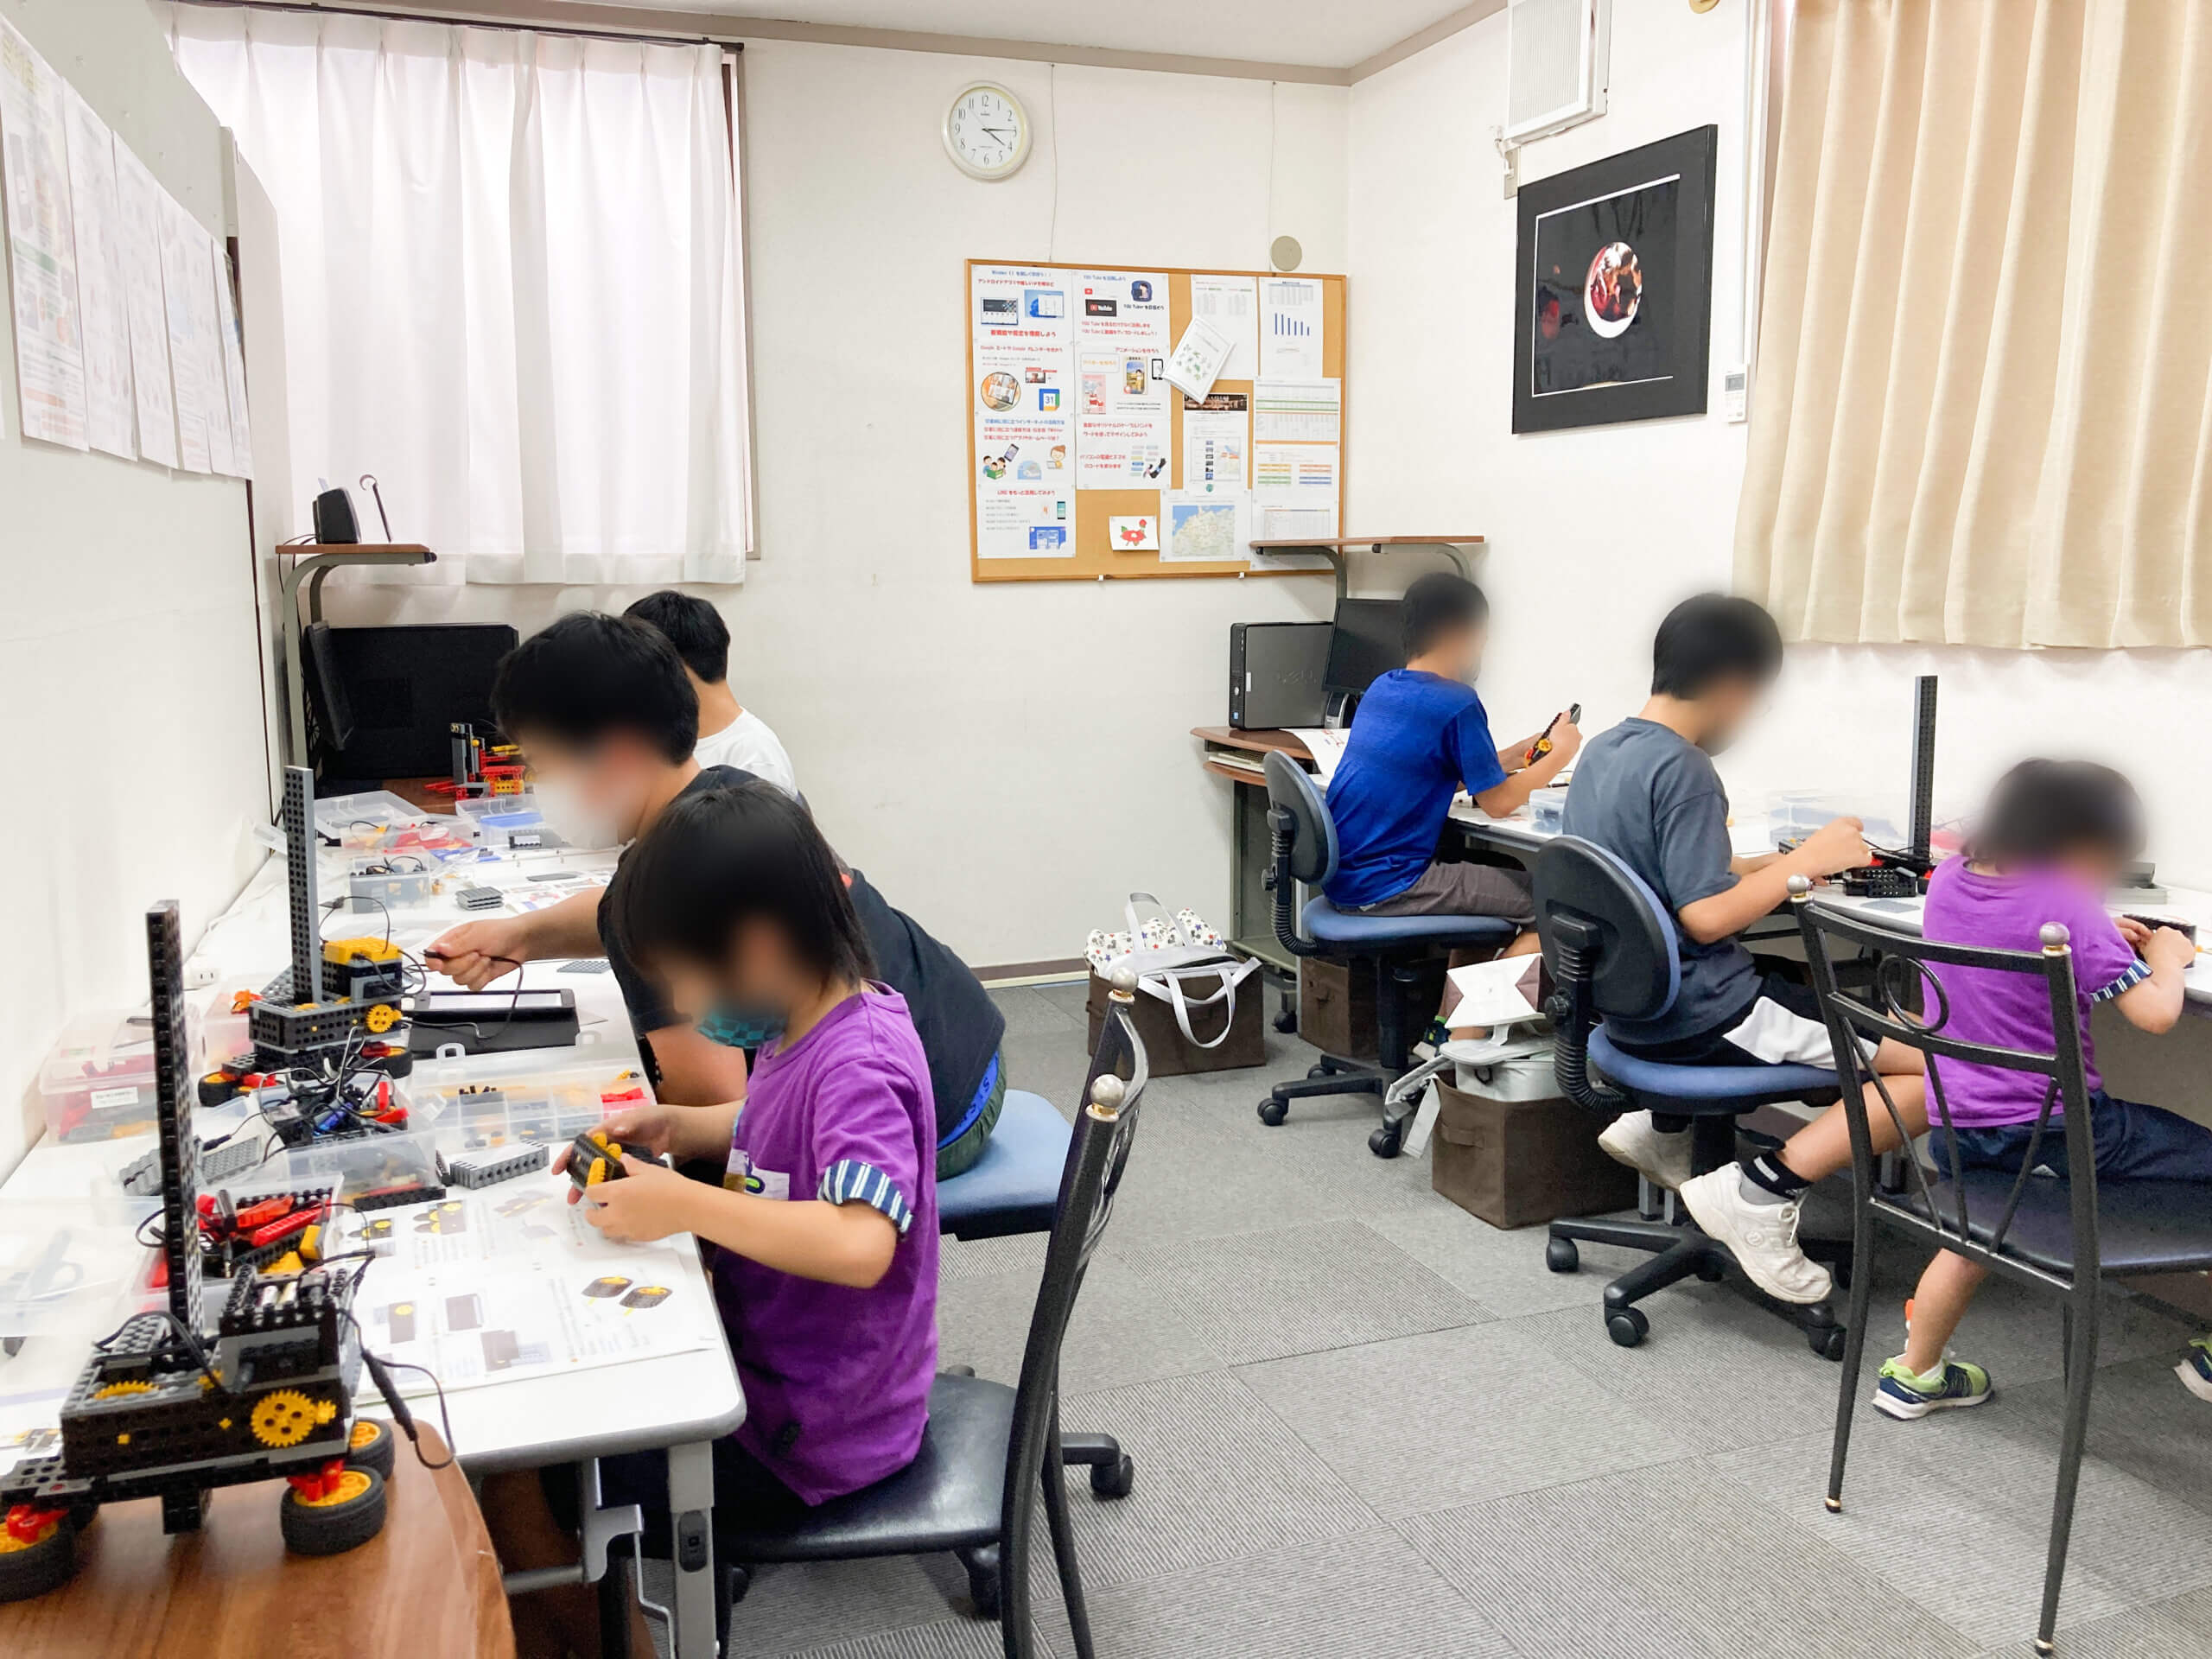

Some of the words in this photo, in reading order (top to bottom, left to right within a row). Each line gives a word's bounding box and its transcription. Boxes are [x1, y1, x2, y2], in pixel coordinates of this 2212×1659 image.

[969, 98, 974, 110] 11
[981, 94, 989, 107] 12
[997, 97, 1001, 111] 1
[958, 108, 966, 120] 10
[1007, 110, 1013, 122] 2
[955, 123, 960, 136] 9
[960, 138, 965, 149] 8
[1007, 141, 1013, 152] 4
[971, 148, 977, 161] 7
[983, 153, 989, 165] 6
[998, 149, 1003, 162] 5
[1045, 396, 1054, 404] 31
